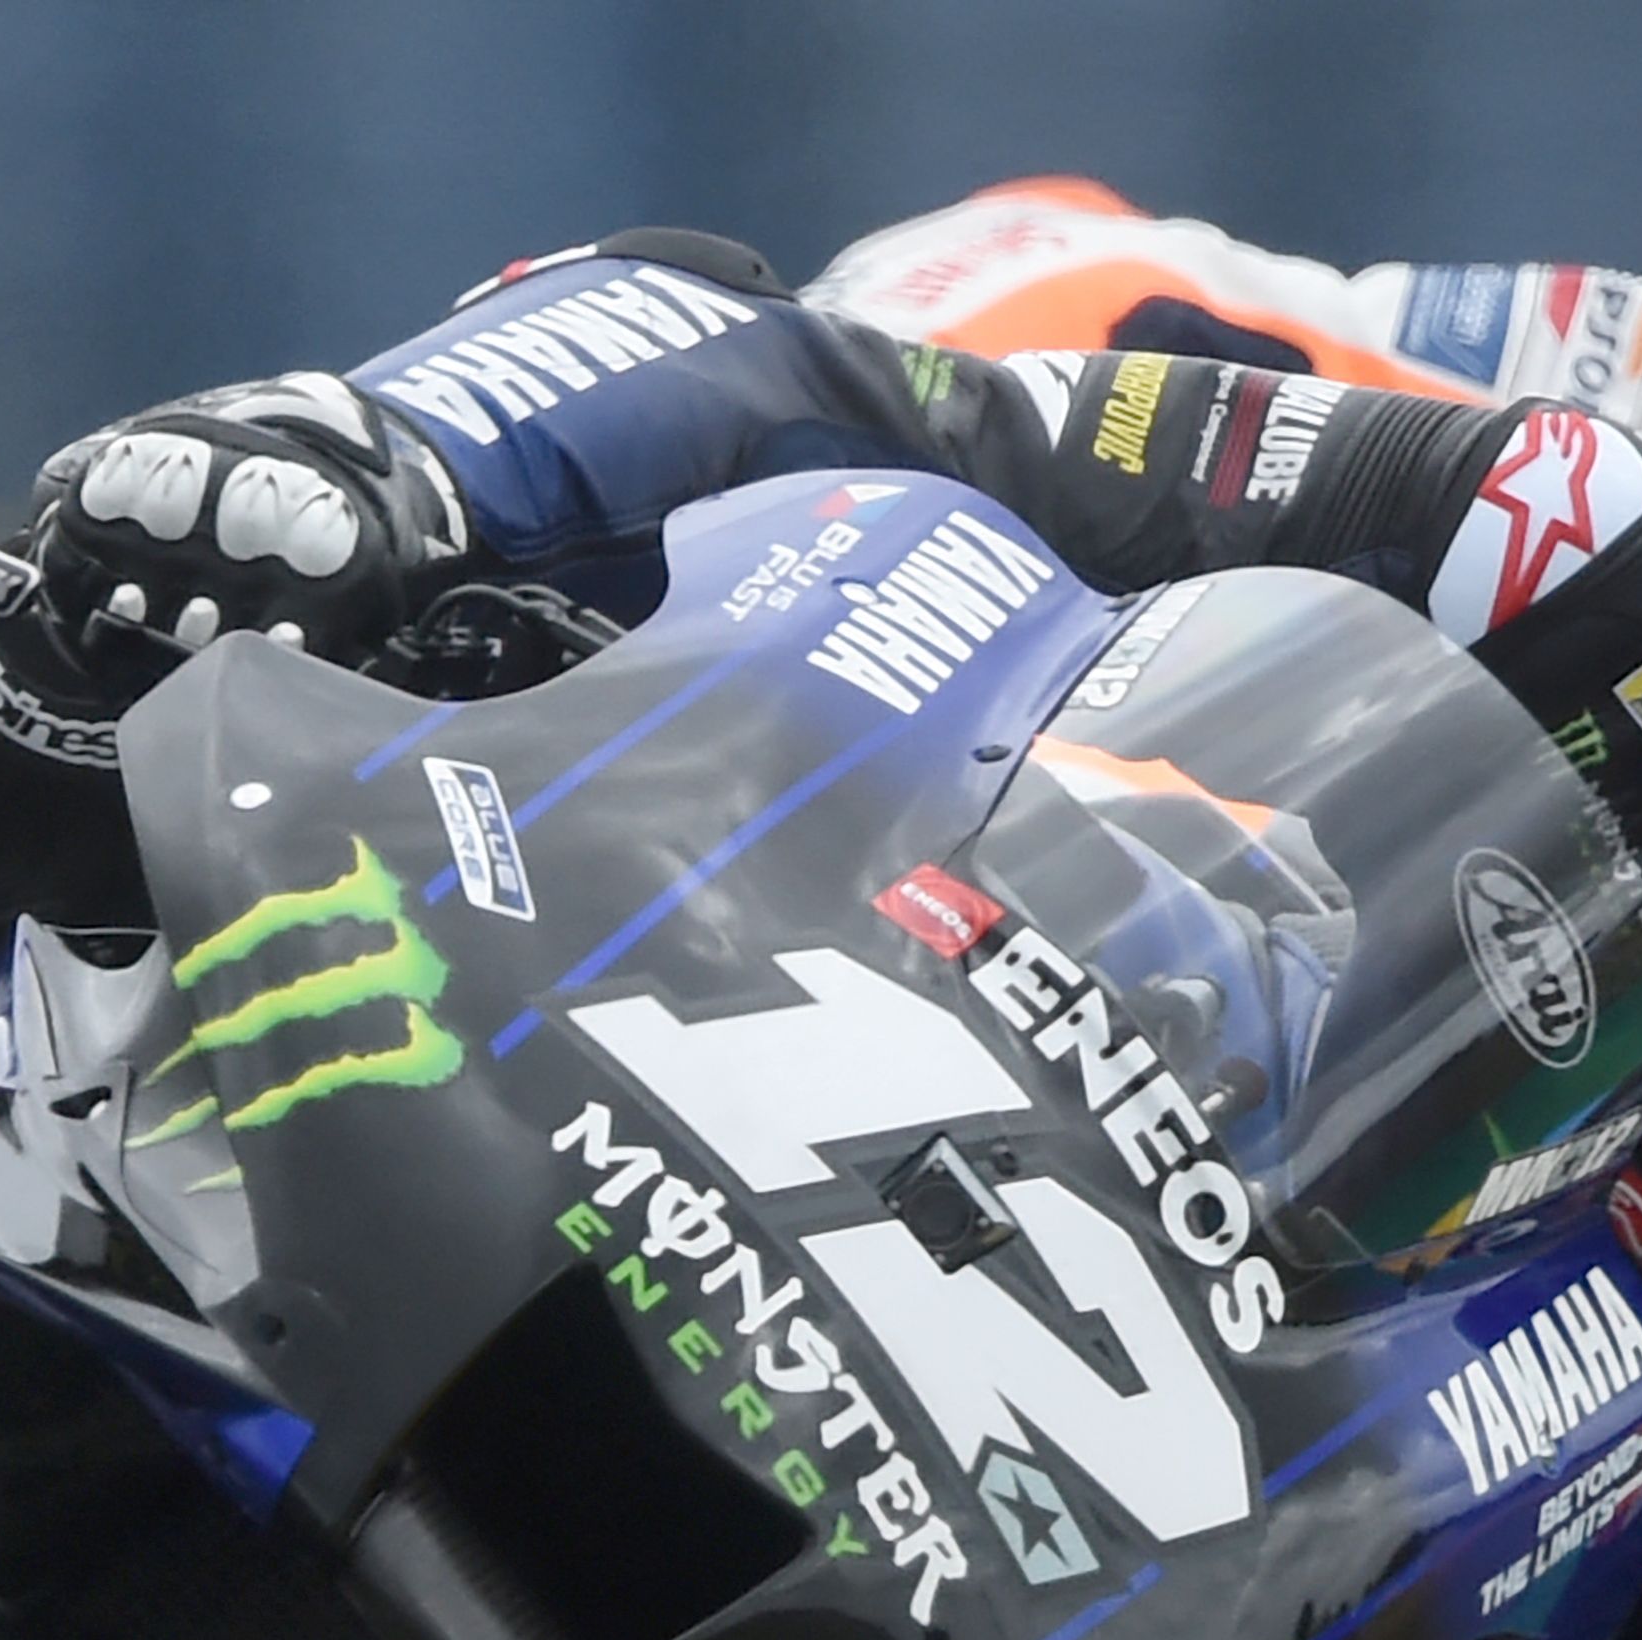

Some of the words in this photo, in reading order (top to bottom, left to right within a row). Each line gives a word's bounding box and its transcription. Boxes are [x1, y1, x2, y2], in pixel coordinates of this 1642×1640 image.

[379, 266, 758, 446] YAMAHA
[720, 542, 800, 623] FAST
[806, 510, 1055, 716] YAMAHA
[437, 778, 487, 882] CORE
[468, 782, 520, 894] BLUE
[899, 881, 973, 940] ENEOS
[968, 925, 1285, 1354] ENEOS
[566, 945, 1252, 1543] 12
[552, 1101, 967, 1627] MONSTER
[554, 1200, 869, 1559] ENERGY
[1479, 1551, 1534, 1617] THE
[1533, 1487, 1617, 1578] LIMITS
[1537, 1432, 1641, 1537] BEYOND
